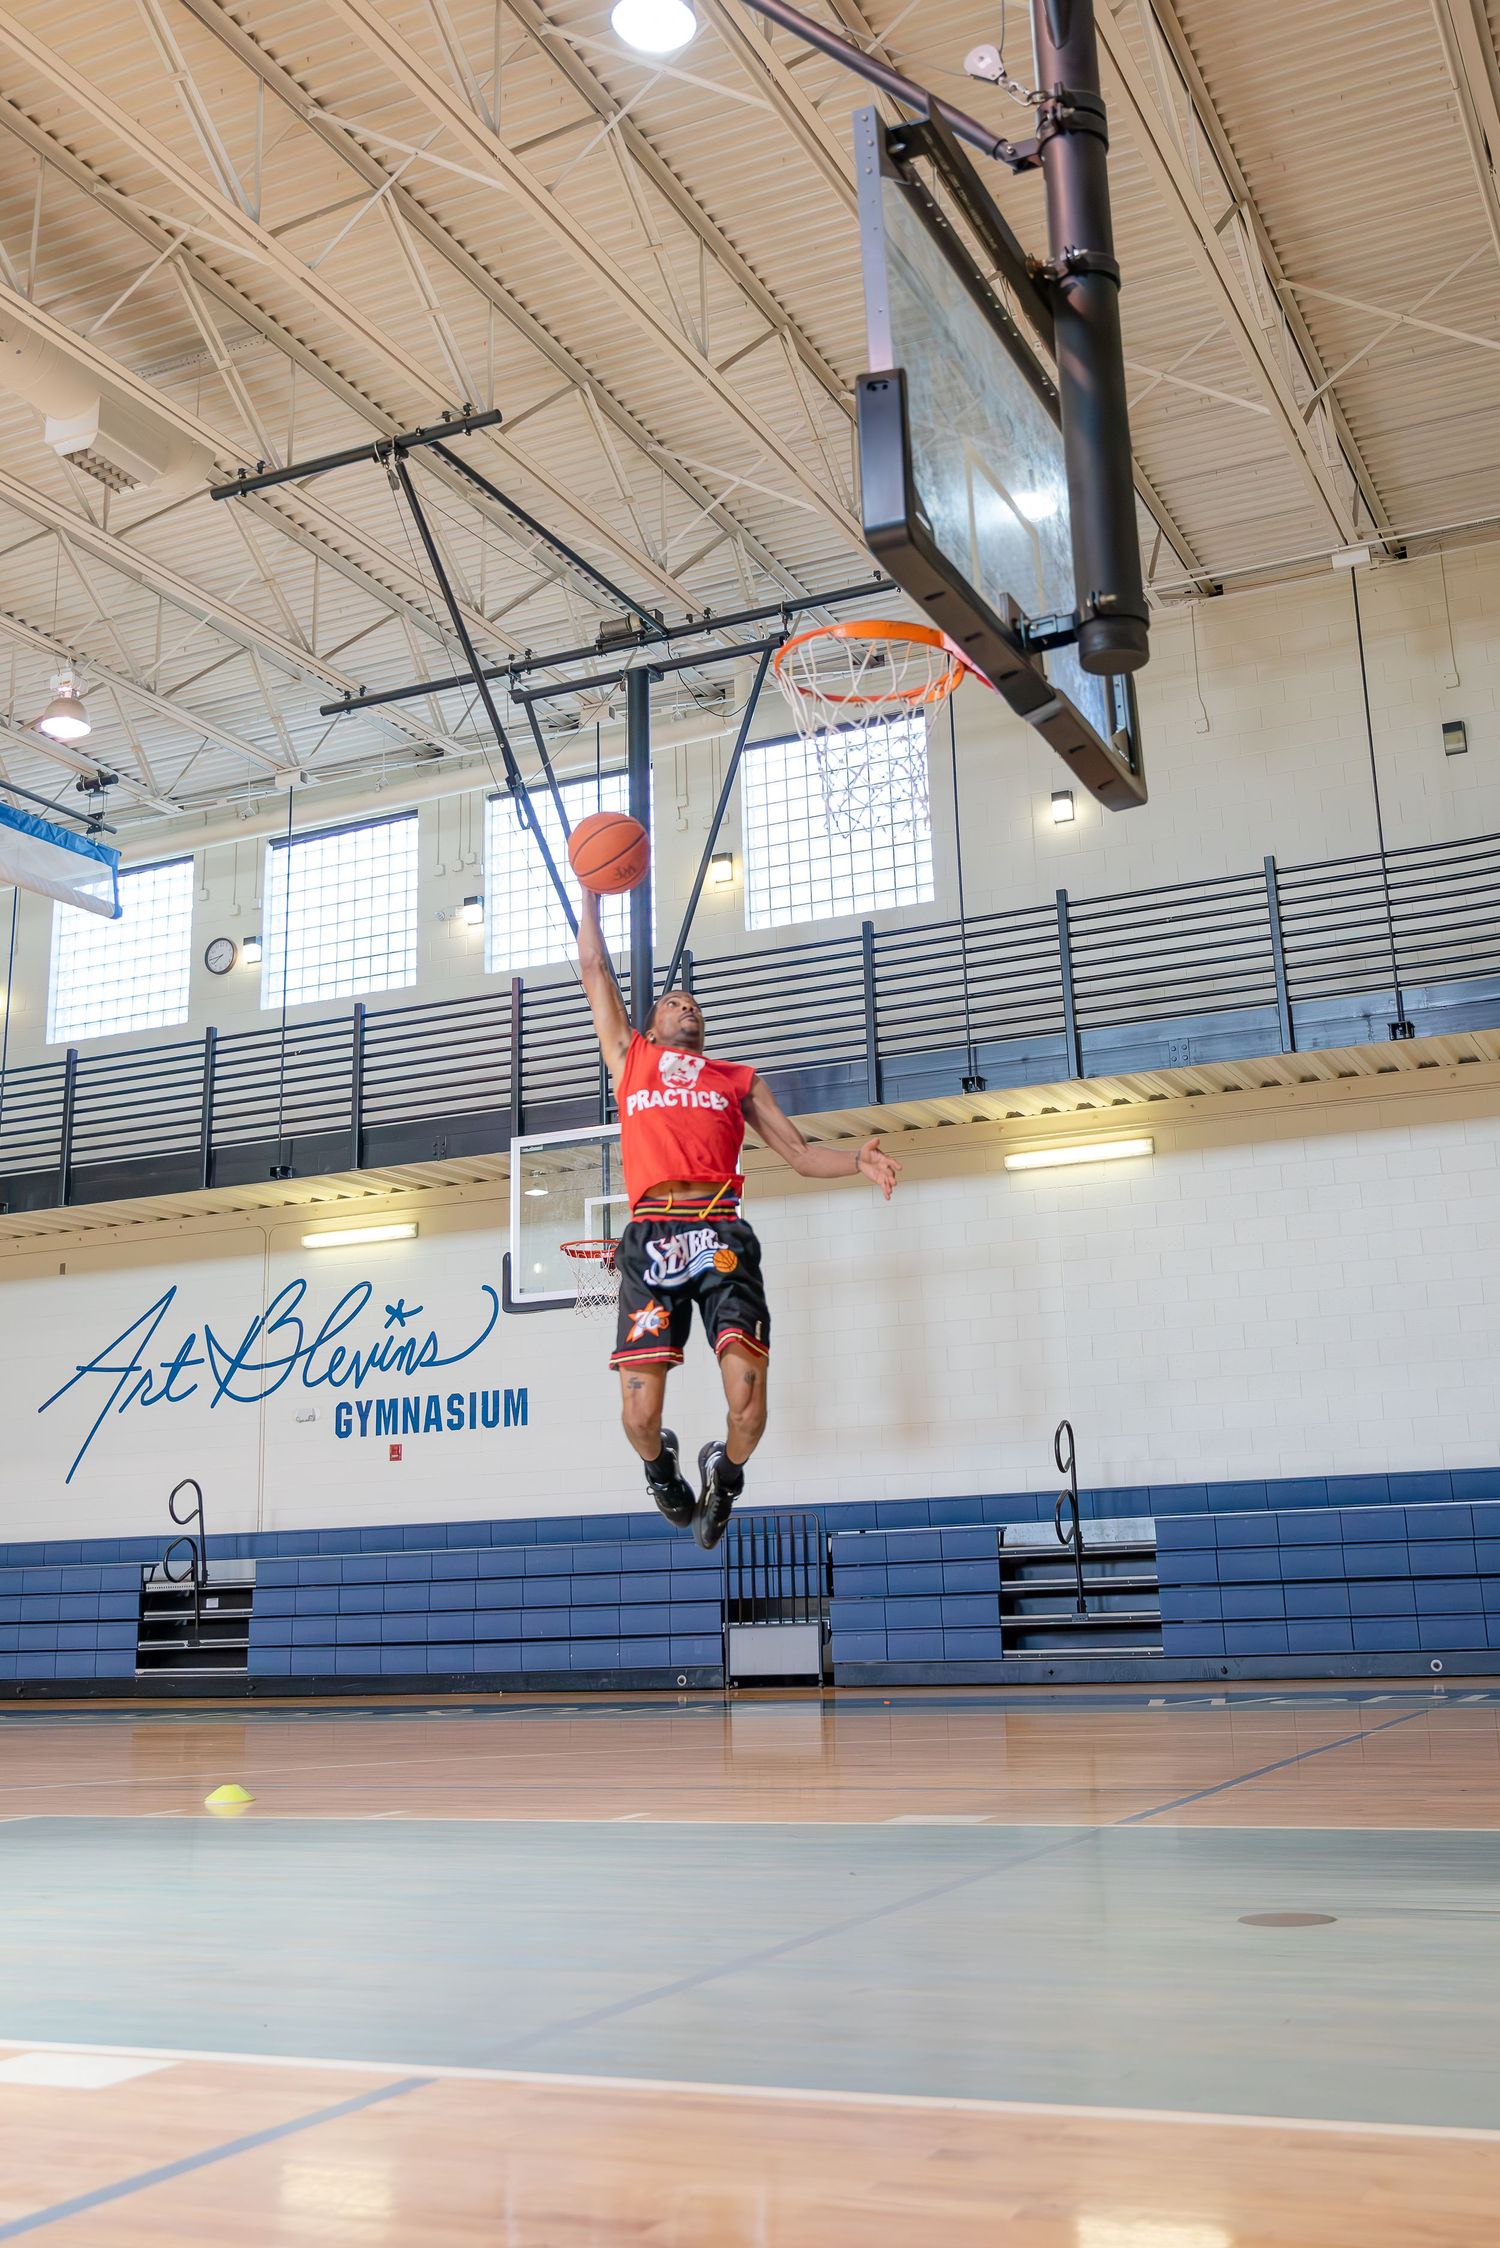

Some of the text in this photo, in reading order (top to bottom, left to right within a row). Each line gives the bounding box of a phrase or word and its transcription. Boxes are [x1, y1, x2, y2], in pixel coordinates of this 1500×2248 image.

[38, 1278, 499, 1484] Art Blevins
[335, 1387, 529, 1439] GYMNASIUM
